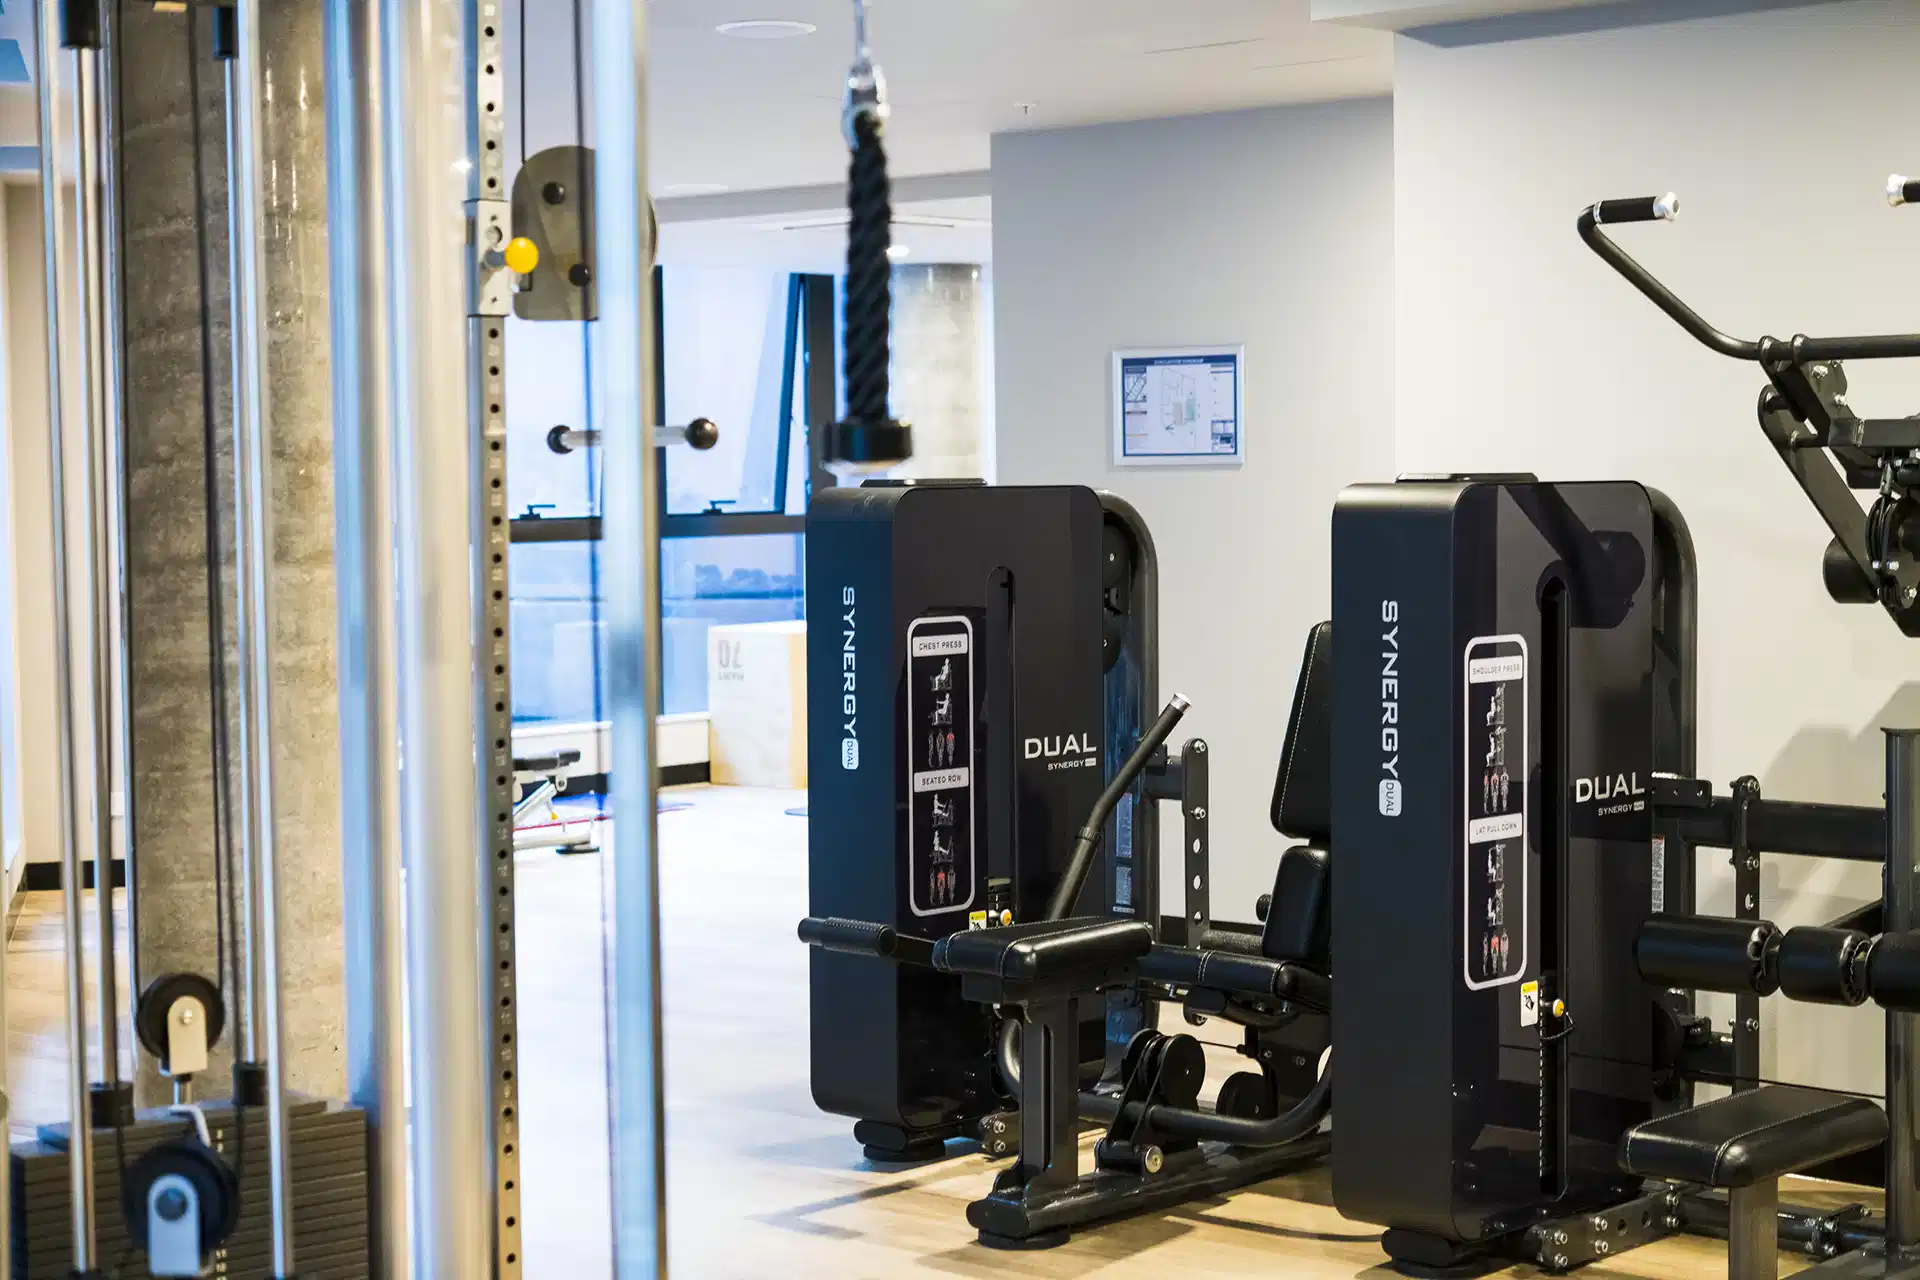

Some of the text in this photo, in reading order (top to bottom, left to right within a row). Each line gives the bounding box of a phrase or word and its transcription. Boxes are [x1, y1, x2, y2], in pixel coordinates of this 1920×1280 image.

[918, 640, 963, 651] CHEST PRESS
[842, 585, 857, 738] SYNERGY
[1472, 665, 1501, 676] SHOULDER
[1382, 599, 1399, 814] SYNERGY DUAL
[1024, 732, 1097, 760] DUAL
[1047, 760, 1084, 771] SYNERGY
[921, 774, 962, 786] SEATED ROW
[1575, 771, 1646, 804] DUAL
[1597, 804, 1634, 817] SYNERGY
[1475, 822, 1518, 836] LAT PULL DOWN
